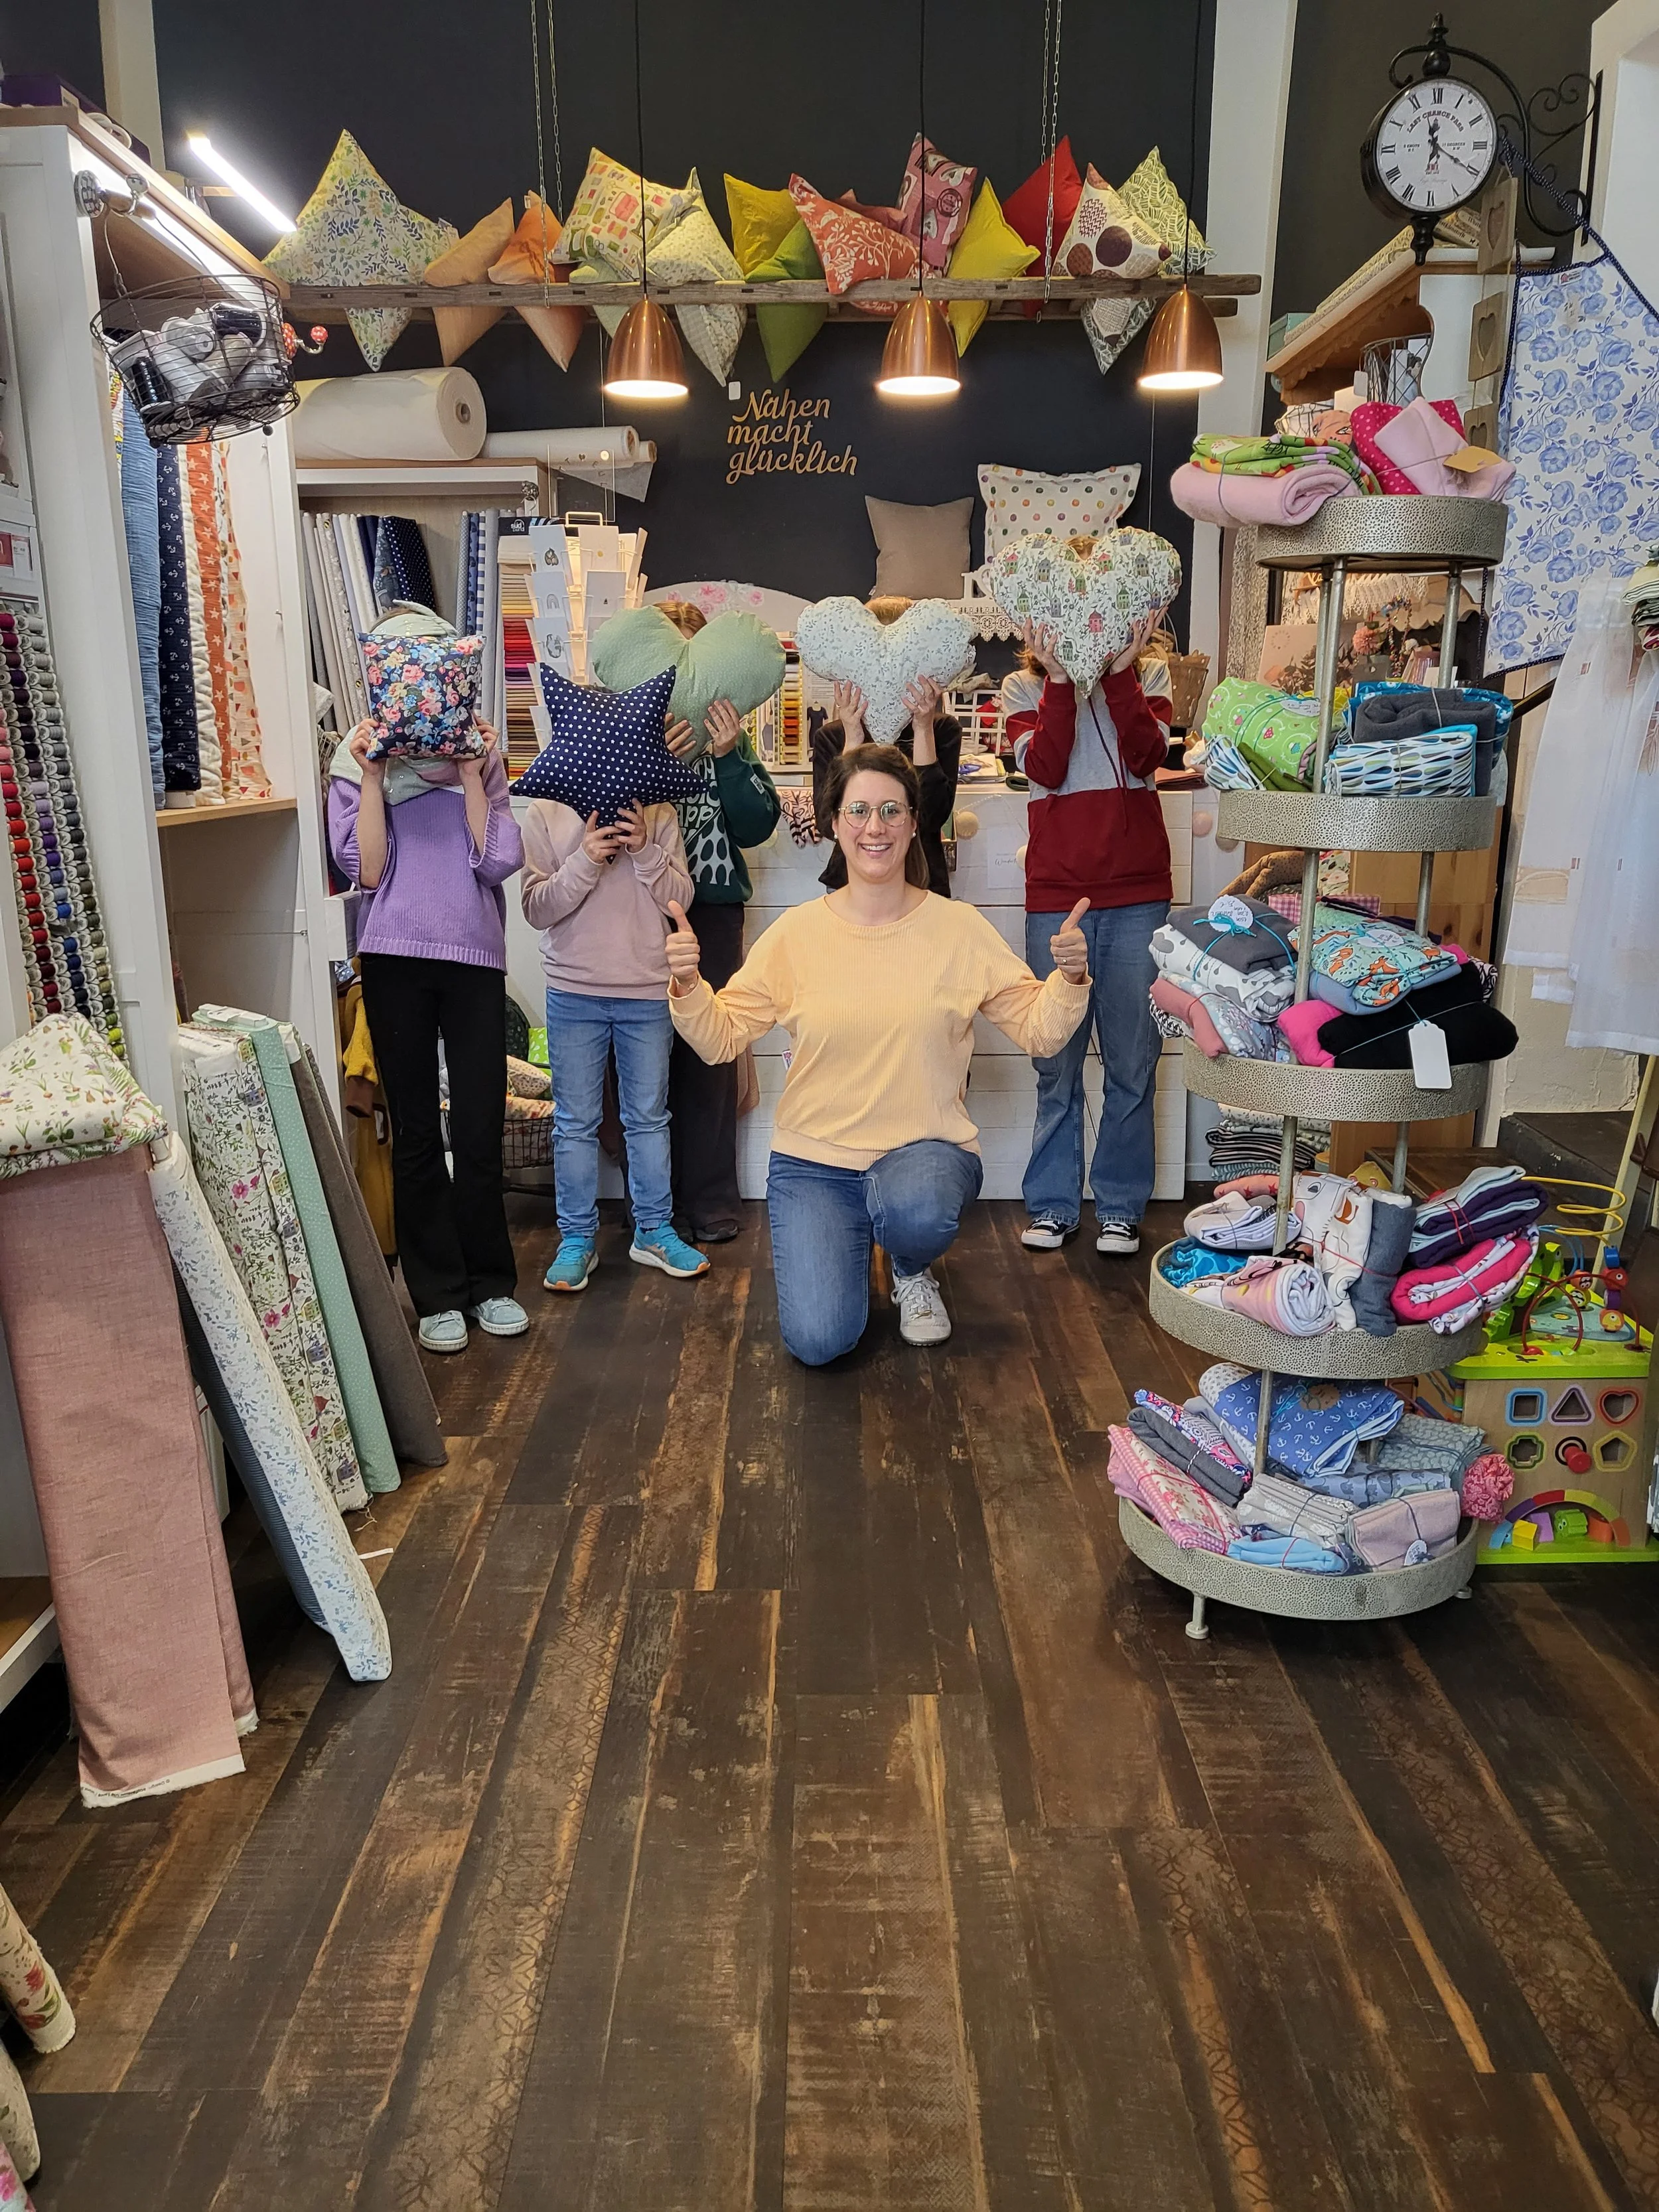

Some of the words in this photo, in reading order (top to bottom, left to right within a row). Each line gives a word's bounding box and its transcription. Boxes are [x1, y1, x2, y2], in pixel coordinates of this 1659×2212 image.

[1408, 94, 1422, 113] XI
[1431, 88, 1443, 105] XII
[1455, 94, 1464, 109] I
[1388, 117, 1404, 131] X
[1407, 115, 1421, 133] LAST
[1422, 110, 1451, 119] CHANCE
[1450, 115, 1464, 132] PASS
[1468, 113, 1483, 128] II
[1472, 141, 1487, 151] III
[1386, 165, 1402, 184] VIII
[1402, 183, 1416, 202] VII
[1426, 190, 1435, 206] VI
[1451, 184, 1461, 200] V
[732, 388, 830, 422] Nähen
[727, 420, 813, 445] macht
[726, 441, 857, 484] glücklich
